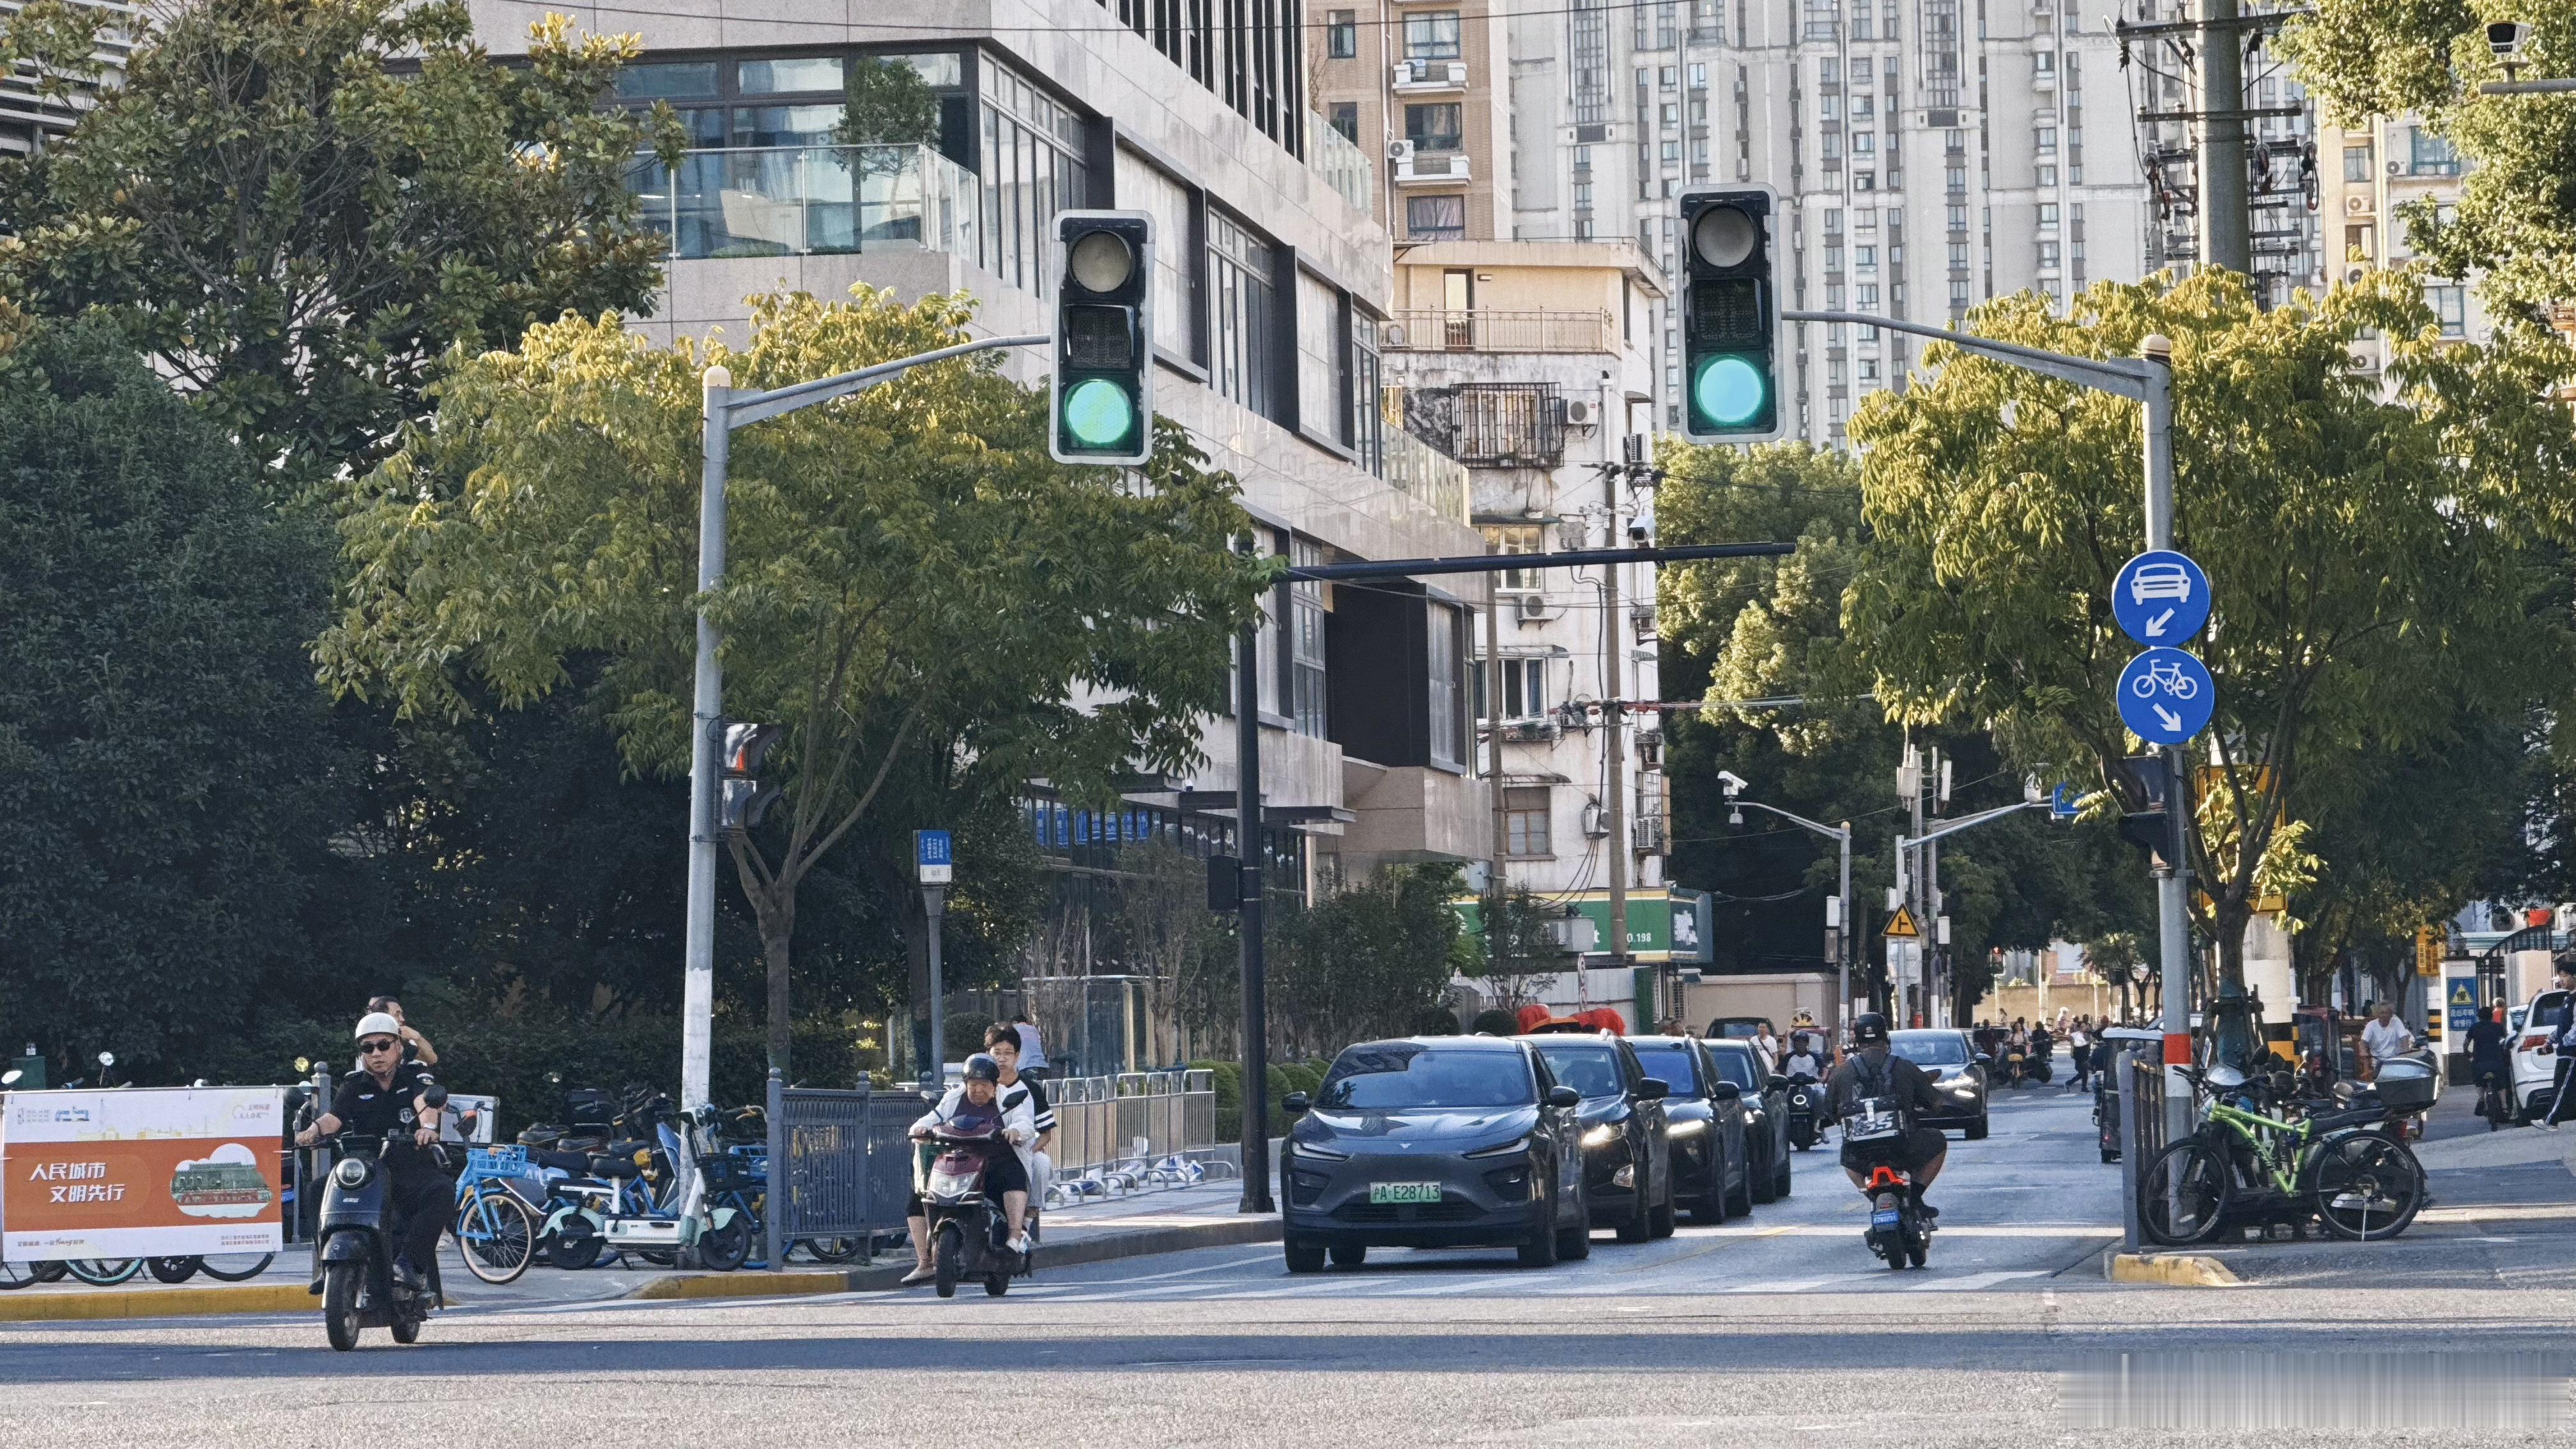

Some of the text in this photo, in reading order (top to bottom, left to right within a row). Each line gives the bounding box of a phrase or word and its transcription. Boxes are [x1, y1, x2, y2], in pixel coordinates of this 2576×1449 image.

[29, 1162, 107, 1181] 人民城市
[49, 1183, 125, 1203] 文明先行
[1393, 1184, 1439, 1200] E28713
